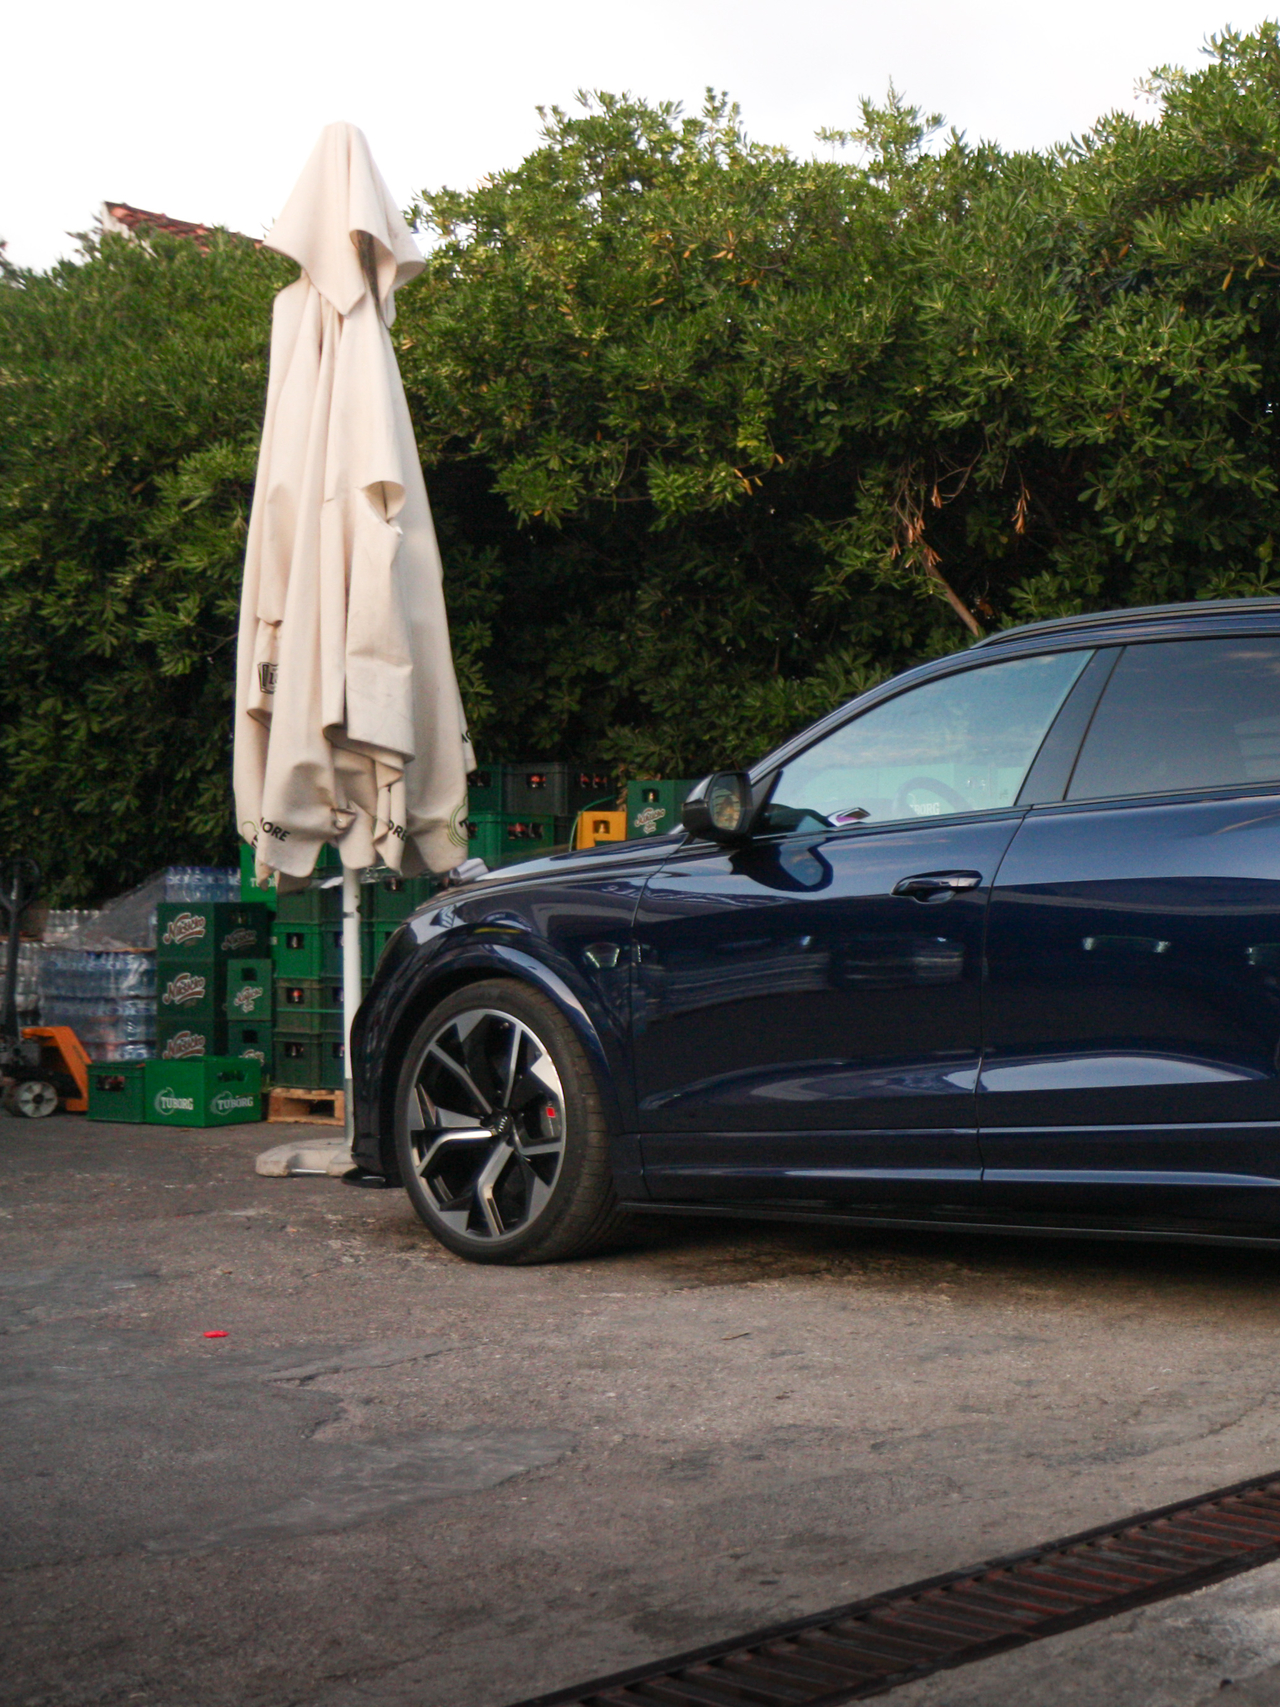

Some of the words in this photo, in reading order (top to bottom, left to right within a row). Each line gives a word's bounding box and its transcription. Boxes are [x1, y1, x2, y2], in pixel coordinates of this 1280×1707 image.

[260, 817, 291, 842] ORE
[161, 1096, 194, 1110] TUBORG
[217, 1096, 254, 1111] TUBORG
